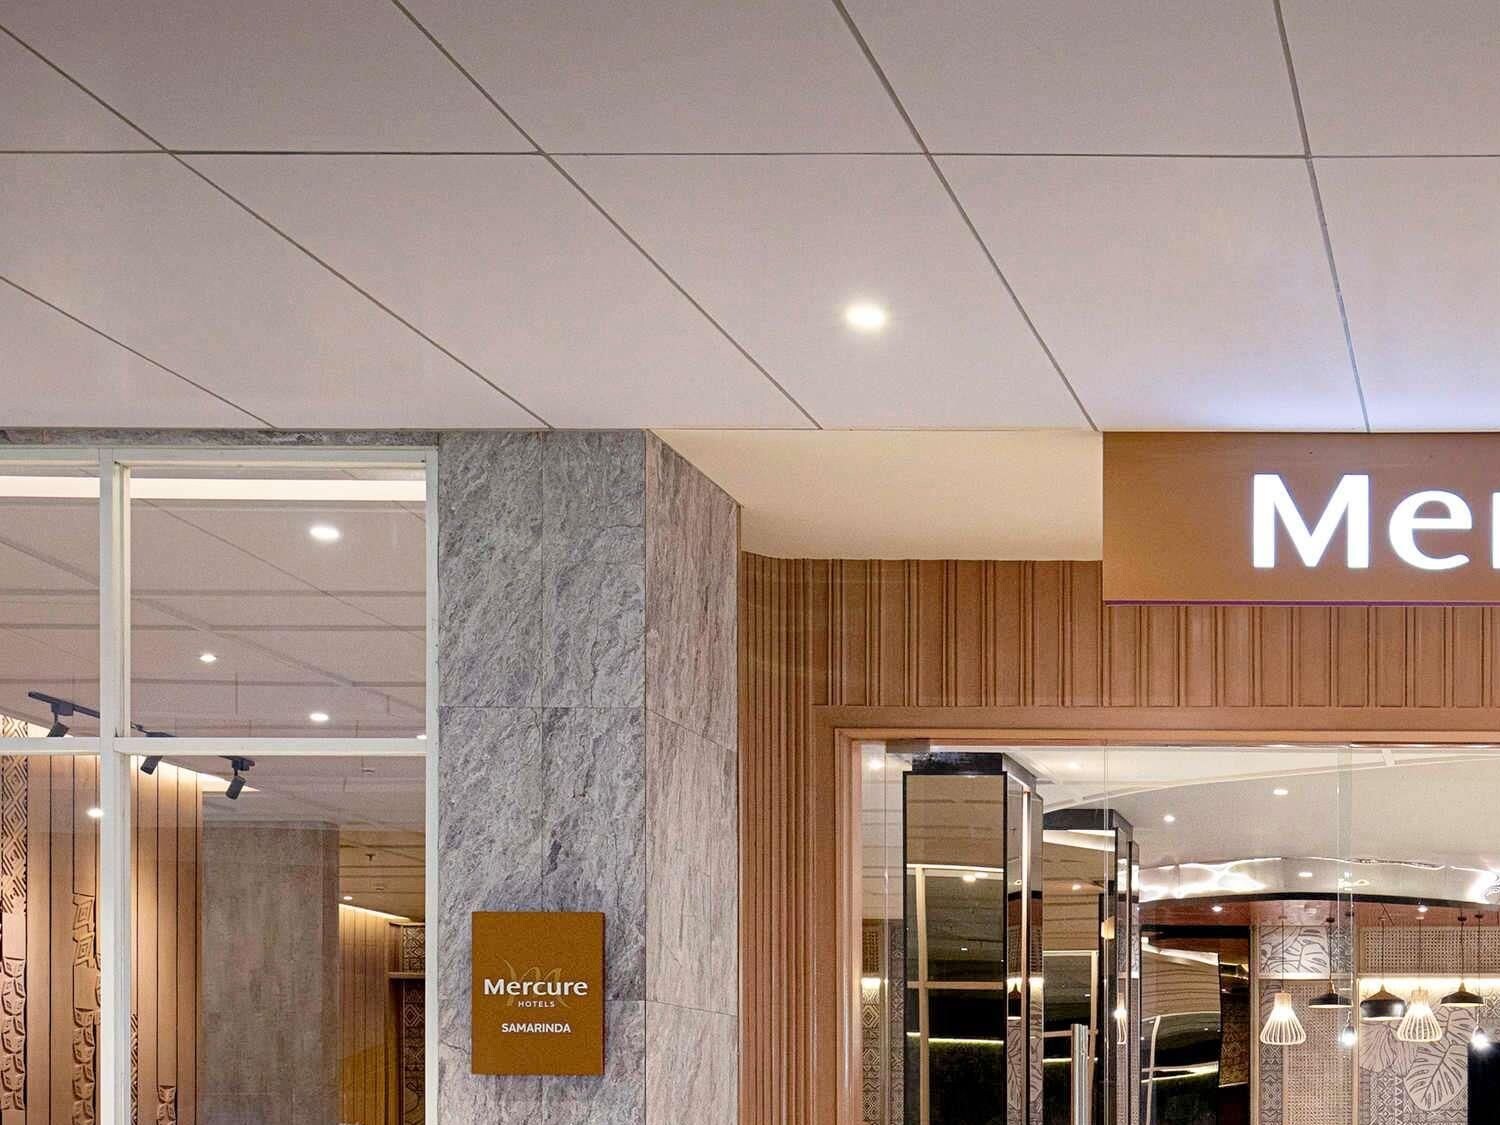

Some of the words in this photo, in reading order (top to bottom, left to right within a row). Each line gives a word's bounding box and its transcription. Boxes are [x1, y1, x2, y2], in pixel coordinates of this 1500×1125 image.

[483, 978, 589, 996] Mercure
[517, 1000, 555, 1008] HOTELS
[501, 1022, 572, 1033] SAMARINDA
